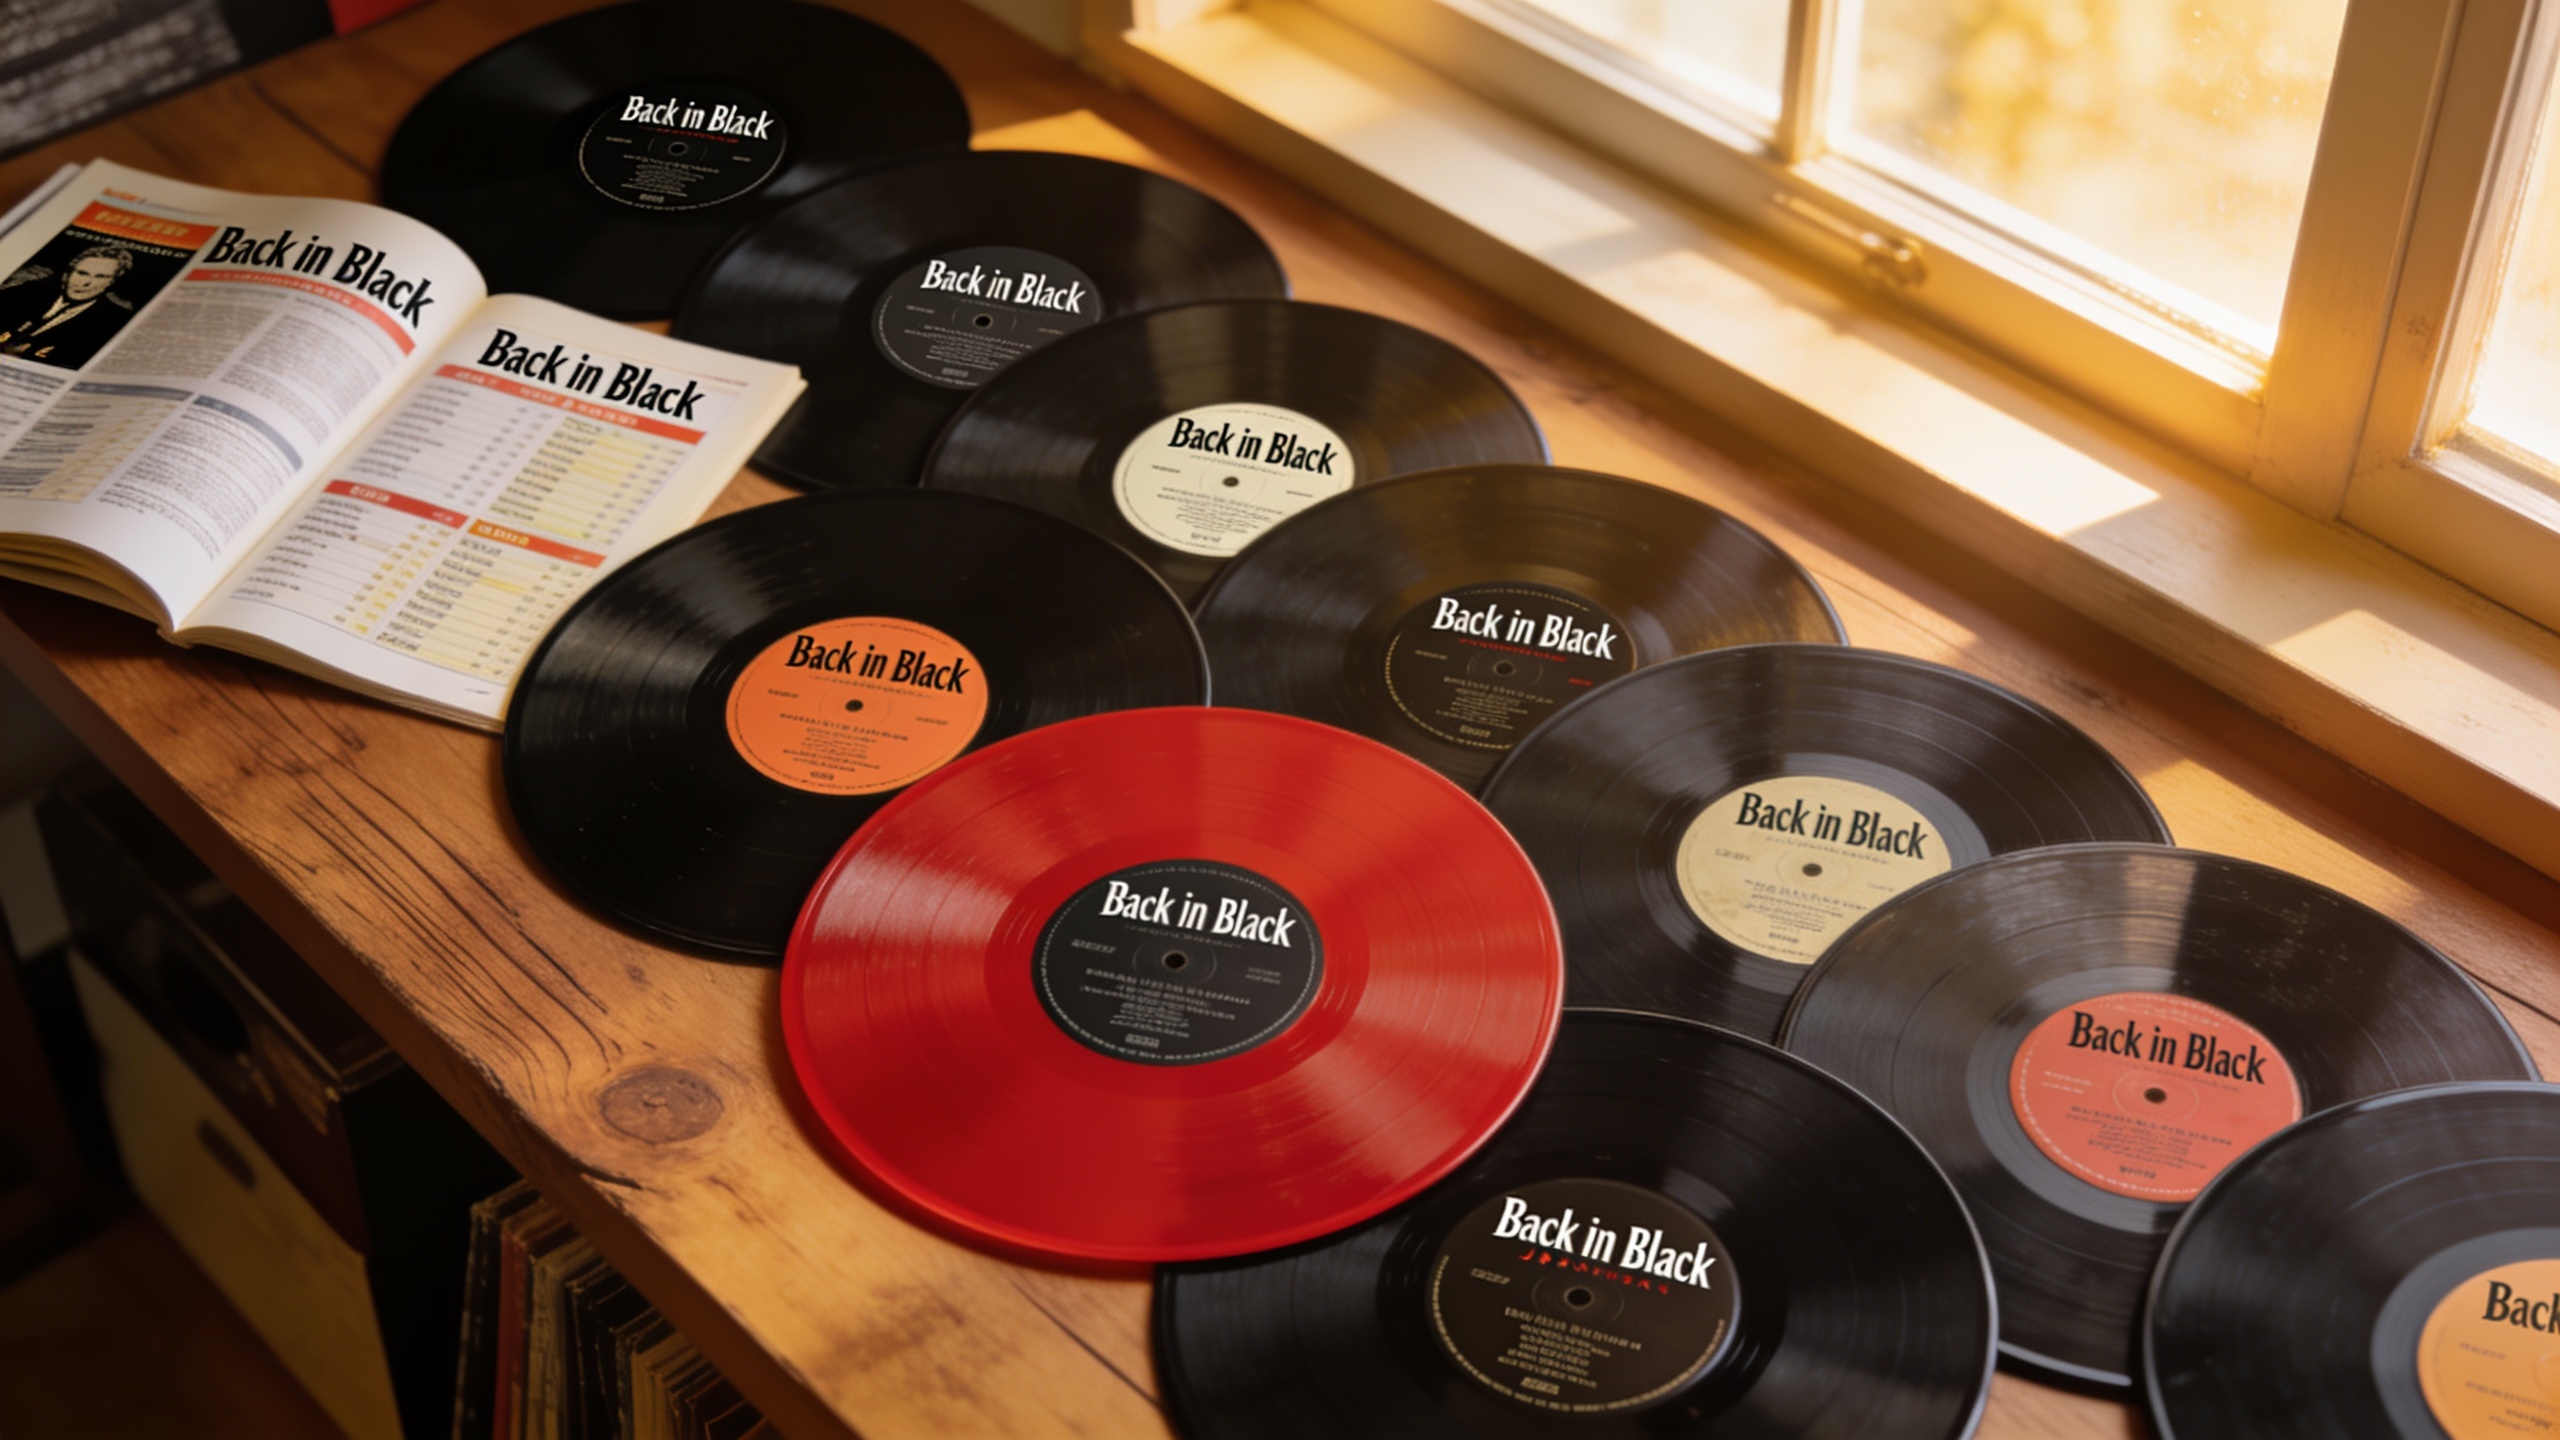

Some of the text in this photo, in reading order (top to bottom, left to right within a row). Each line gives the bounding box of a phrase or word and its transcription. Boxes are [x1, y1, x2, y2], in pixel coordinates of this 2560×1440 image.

[620, 95, 679, 127] Back
[680, 101, 705, 130] in
[706, 104, 774, 140] Black
[201, 225, 298, 269] Back
[291, 235, 335, 277] in
[332, 242, 434, 329] Black
[920, 259, 1086, 314] Back in Black
[477, 328, 569, 384] Back
[565, 353, 604, 395] in
[602, 362, 705, 421] Black
[1167, 417, 1338, 476] Back in Black
[1431, 597, 1503, 639] Back
[1505, 609, 1536, 645] in
[1538, 614, 1617, 660] Black
[785, 634, 970, 694] Back in Black
[1734, 791, 1928, 860] Back in Black
[1099, 880, 1297, 948] Back in Black
[2067, 1010, 2268, 1085] Back in Black
[1493, 1196, 1580, 1253] Back
[1581, 1217, 1617, 1263] in
[1619, 1226, 1717, 1290] Black
